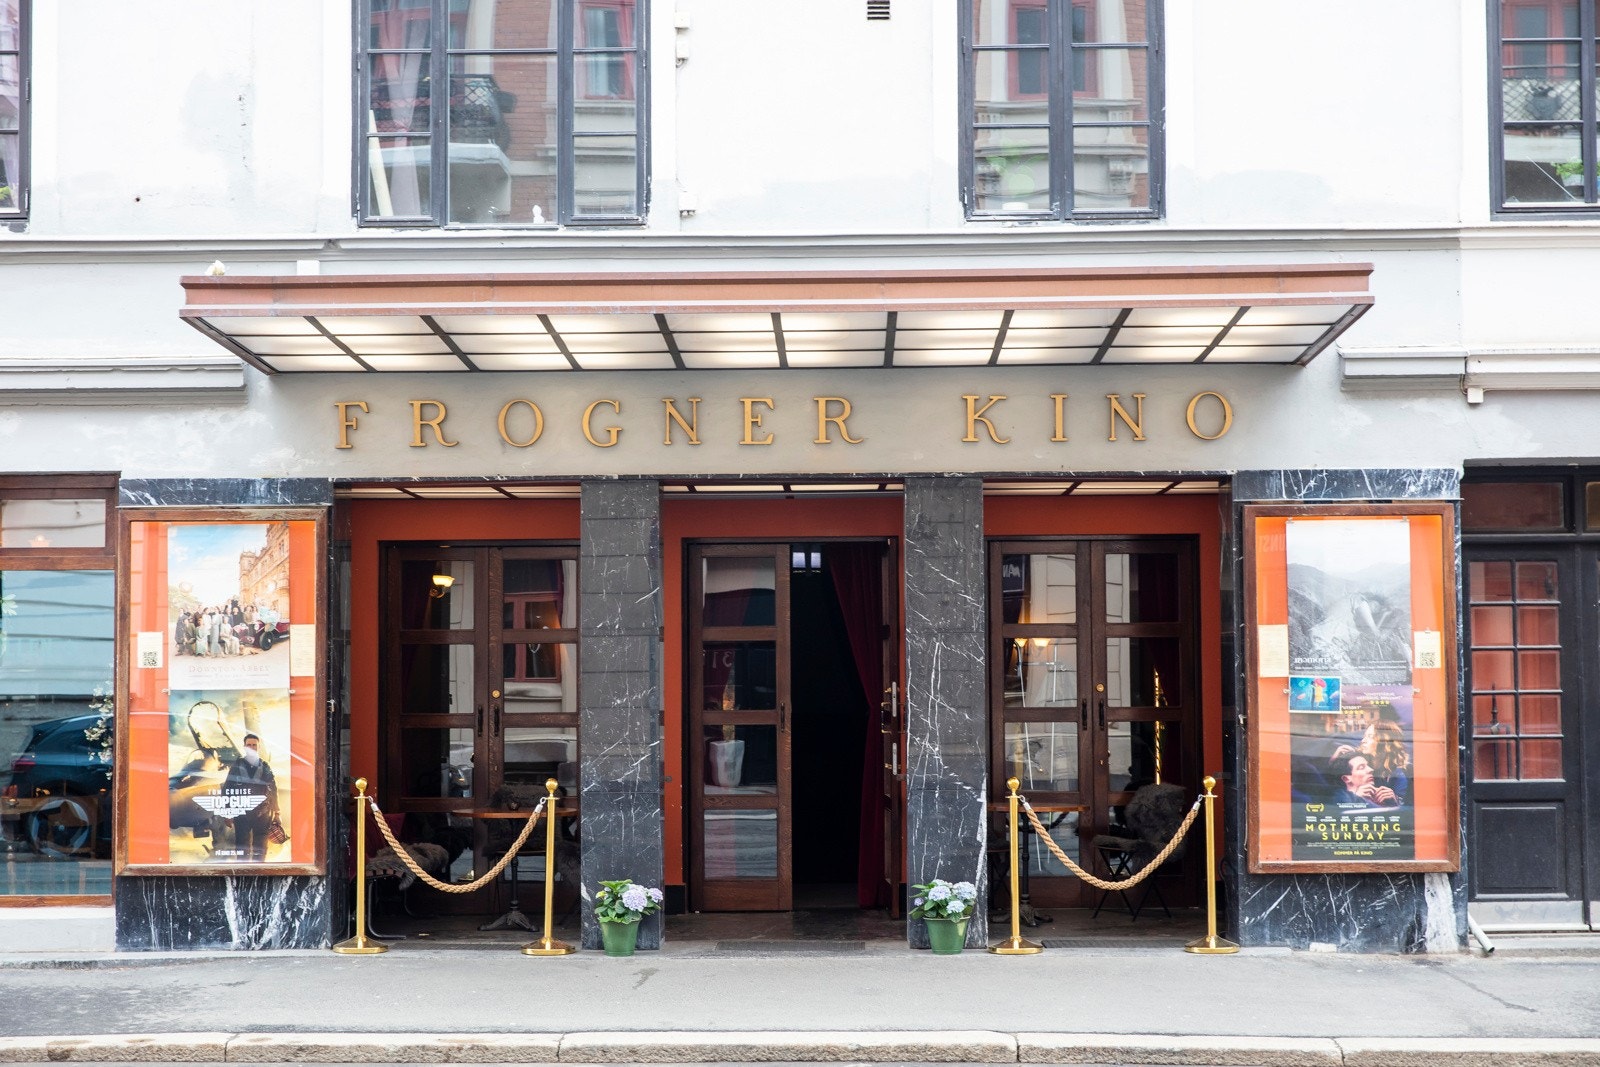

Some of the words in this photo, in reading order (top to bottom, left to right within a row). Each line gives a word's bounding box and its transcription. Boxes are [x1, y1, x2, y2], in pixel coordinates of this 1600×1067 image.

[334, 396, 864, 449] FROGNER
[962, 391, 1234, 444] KINO
[211, 796, 230, 809] TOP
[229, 795, 251, 808] GUN
[1305, 823, 1401, 832] MOTHERING
[1322, 832, 1385, 840] SUNDAY
